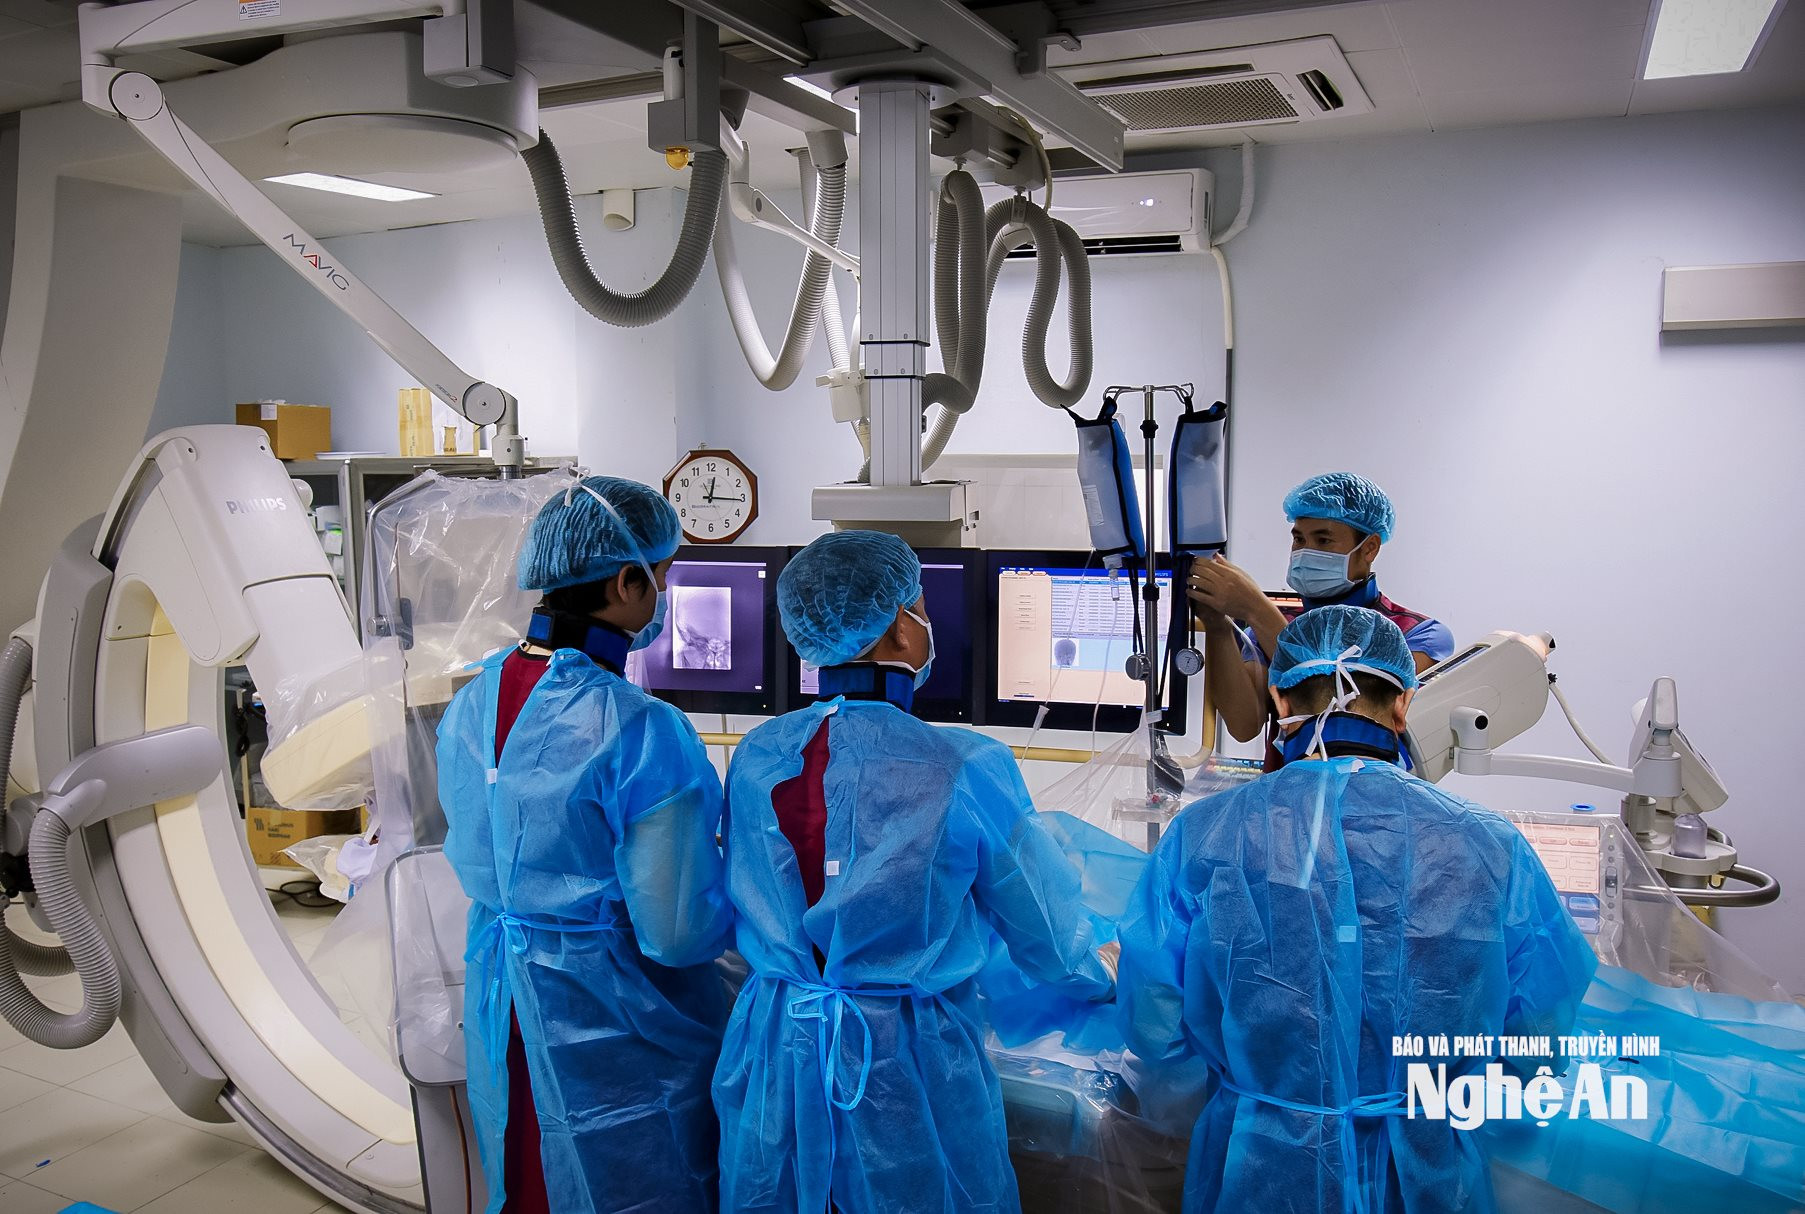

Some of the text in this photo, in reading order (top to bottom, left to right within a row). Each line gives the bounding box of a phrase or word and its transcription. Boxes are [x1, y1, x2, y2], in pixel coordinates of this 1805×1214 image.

[282, 233, 350, 291] MAVIG
[691, 467, 700, 477] 11
[706, 462, 716, 472] 12
[725, 467, 730, 476] 1
[680, 478, 689, 488] 10
[735, 478, 741, 488] 2
[675, 492, 681, 502] 9
[740, 493, 746, 503] 3
[225, 497, 287, 514] PHILIPS
[680, 508, 686, 518] 8
[734, 508, 740, 518] 4
[691, 519, 697, 528] 7
[708, 523, 714, 532] 6
[724, 519, 730, 528] 5
